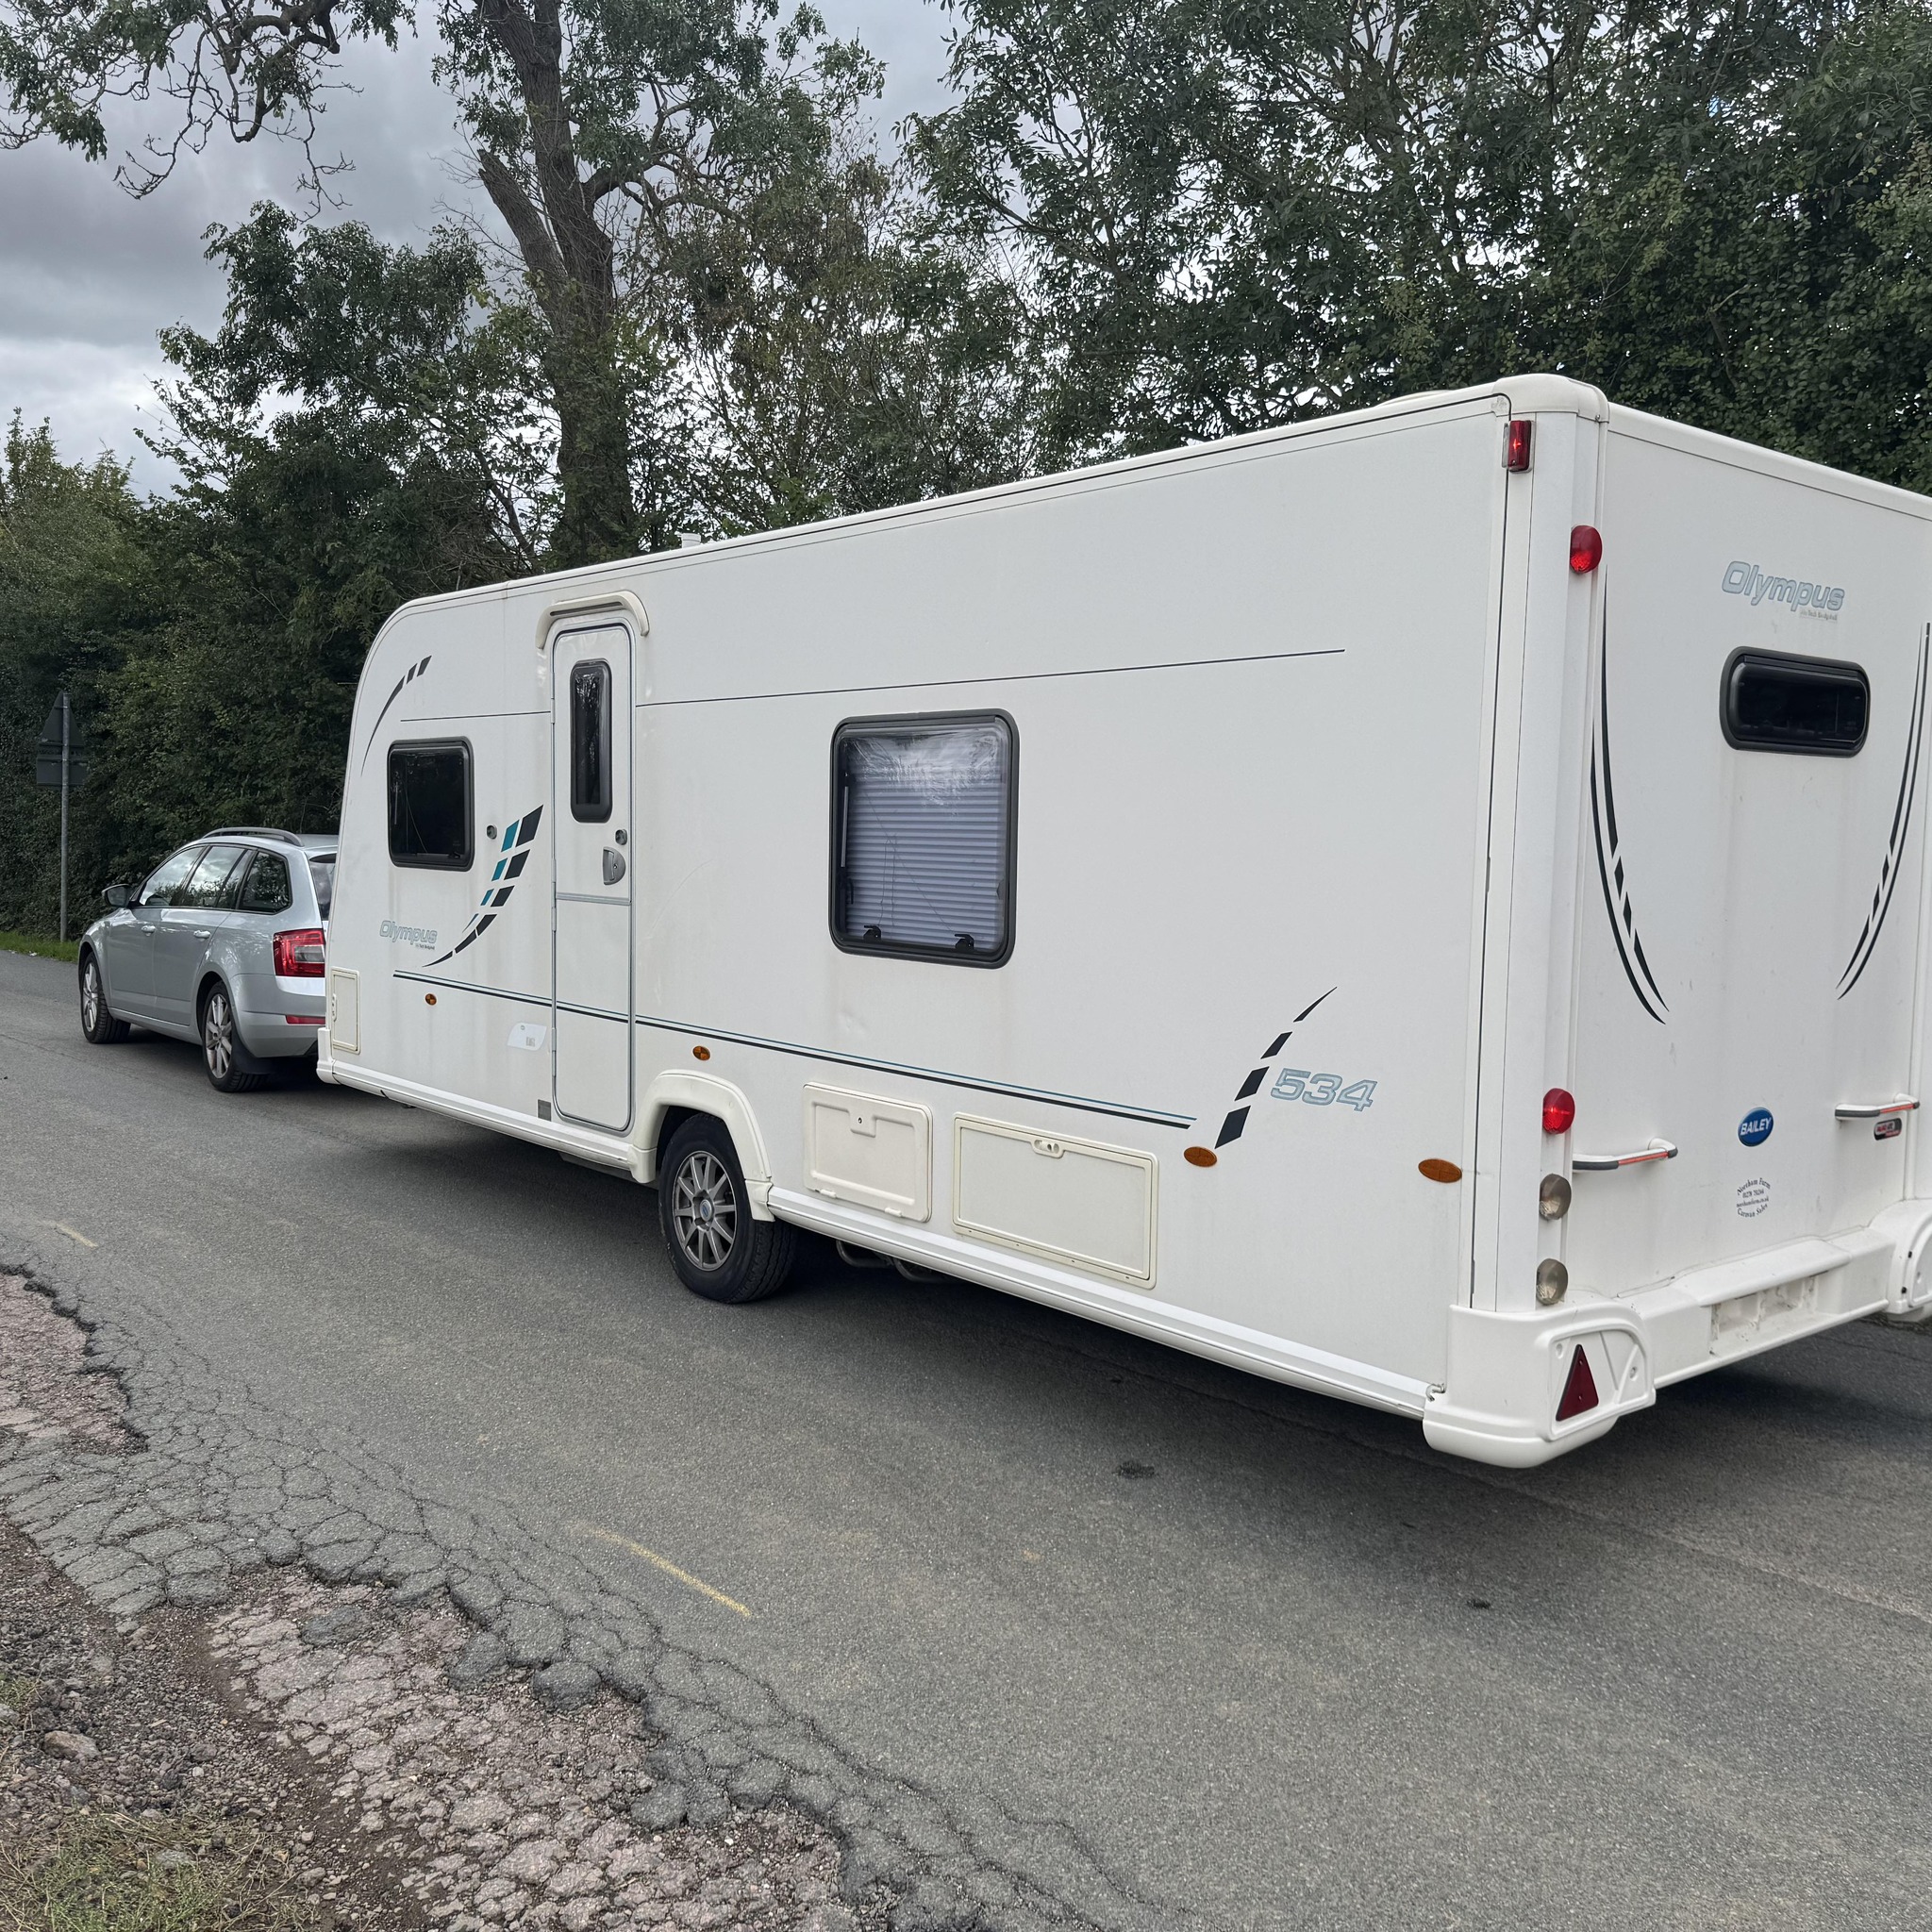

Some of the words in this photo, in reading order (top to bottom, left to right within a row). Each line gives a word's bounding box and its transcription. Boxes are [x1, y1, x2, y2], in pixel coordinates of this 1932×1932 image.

[1722, 560, 1845, 612] Olympus
[379, 920, 438, 945] Olympus
[1270, 1067, 1378, 1112] 534
[1740, 1117, 1772, 1136] BAILEY
[1758, 1177, 1771, 1190] Farm
[1756, 1203, 1768, 1215] Sales
